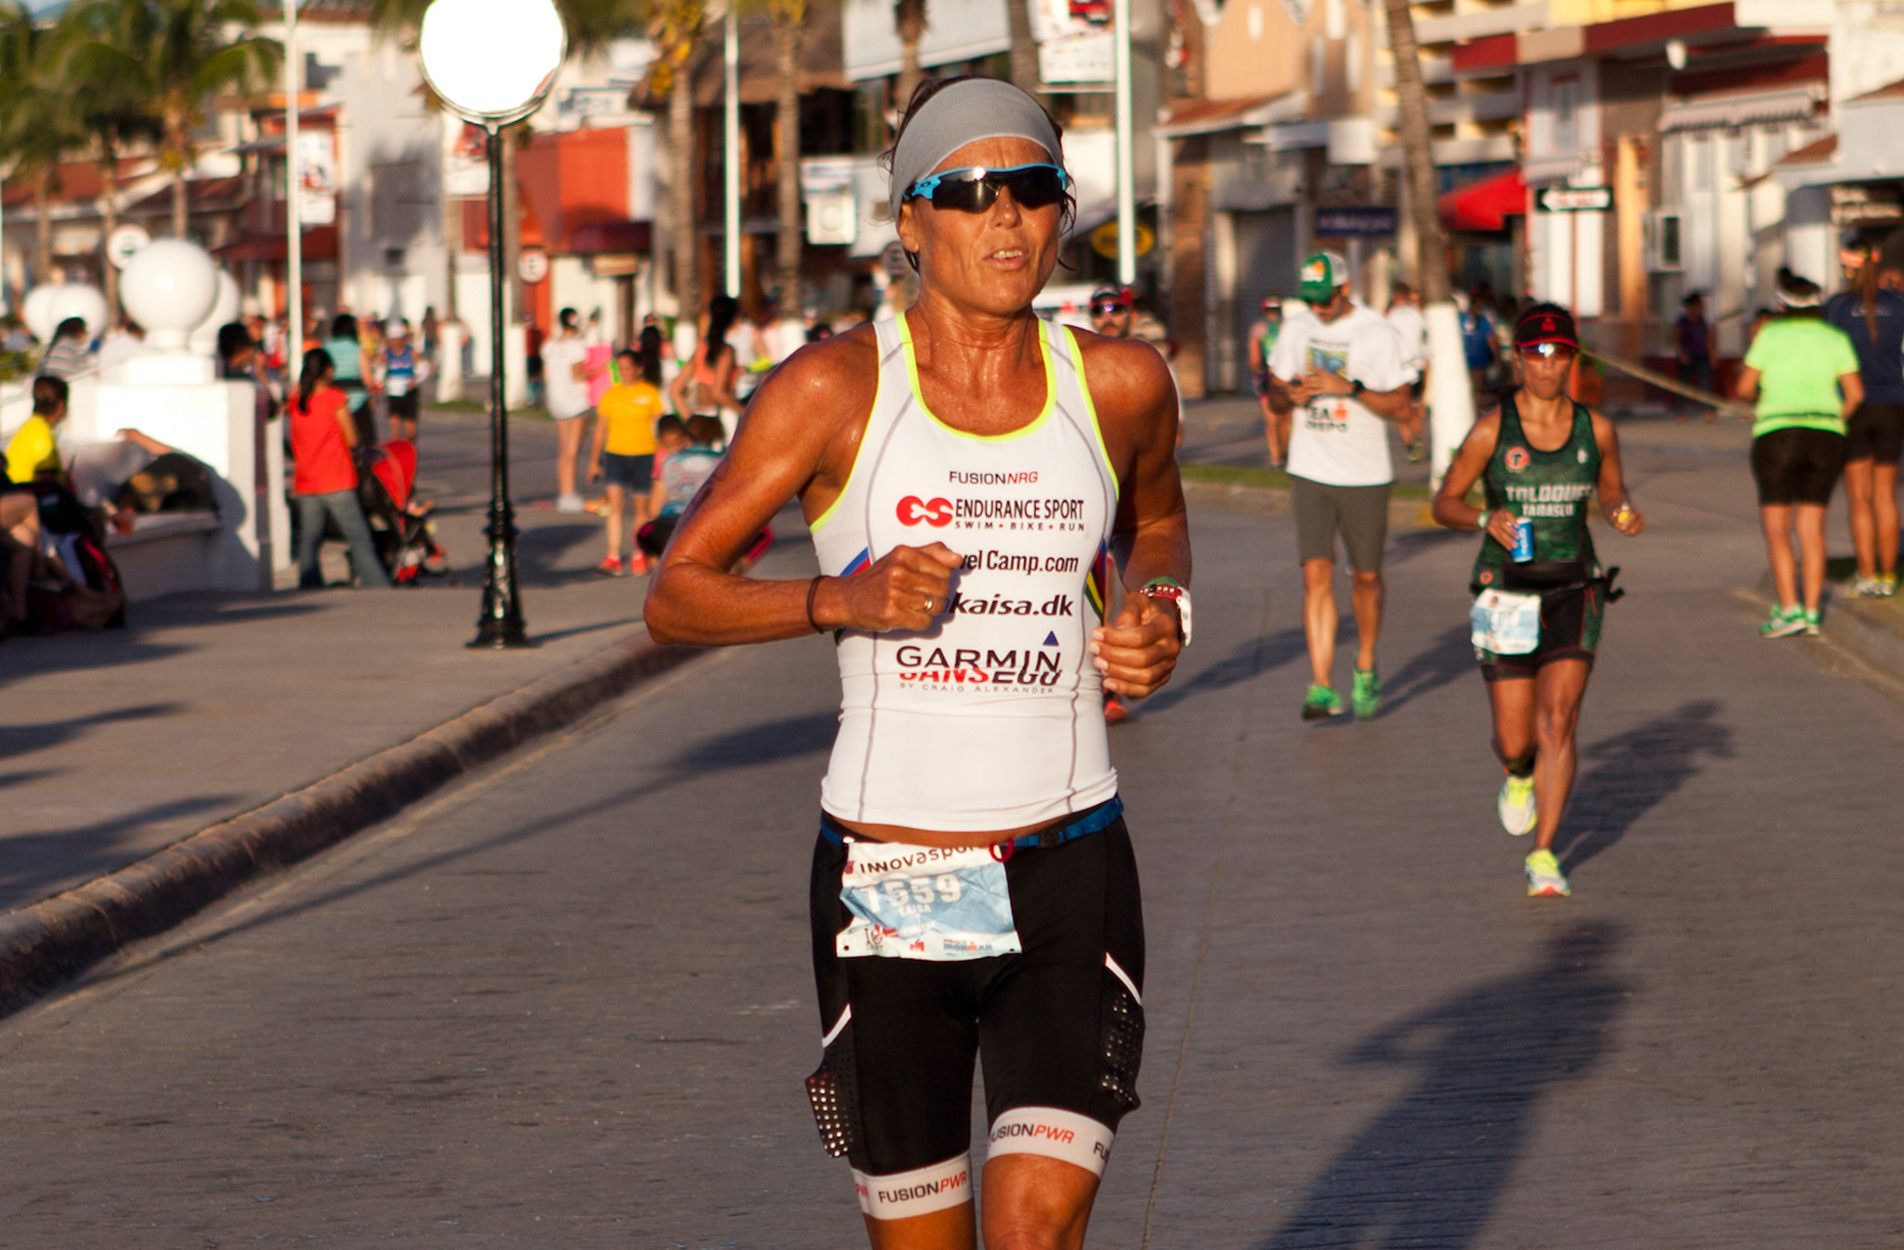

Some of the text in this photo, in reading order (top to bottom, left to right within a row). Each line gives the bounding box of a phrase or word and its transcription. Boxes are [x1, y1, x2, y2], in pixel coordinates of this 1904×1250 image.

[949, 471, 1038, 485] FUSIONNRG
[955, 499, 1084, 520] ENDURANCE SPORT
[955, 521, 1085, 532] SWIM BIKE RUN
[986, 549, 1079, 576] Camp.com
[896, 645, 1061, 673] GARMIN
[922, 684, 965, 693] CRAIG
[974, 686, 1054, 695] ALEXANDER
[861, 873, 962, 914] 1559
[990, 1123, 1075, 1144] USIONPWR
[878, 1171, 967, 1204] FUSIONPWR
